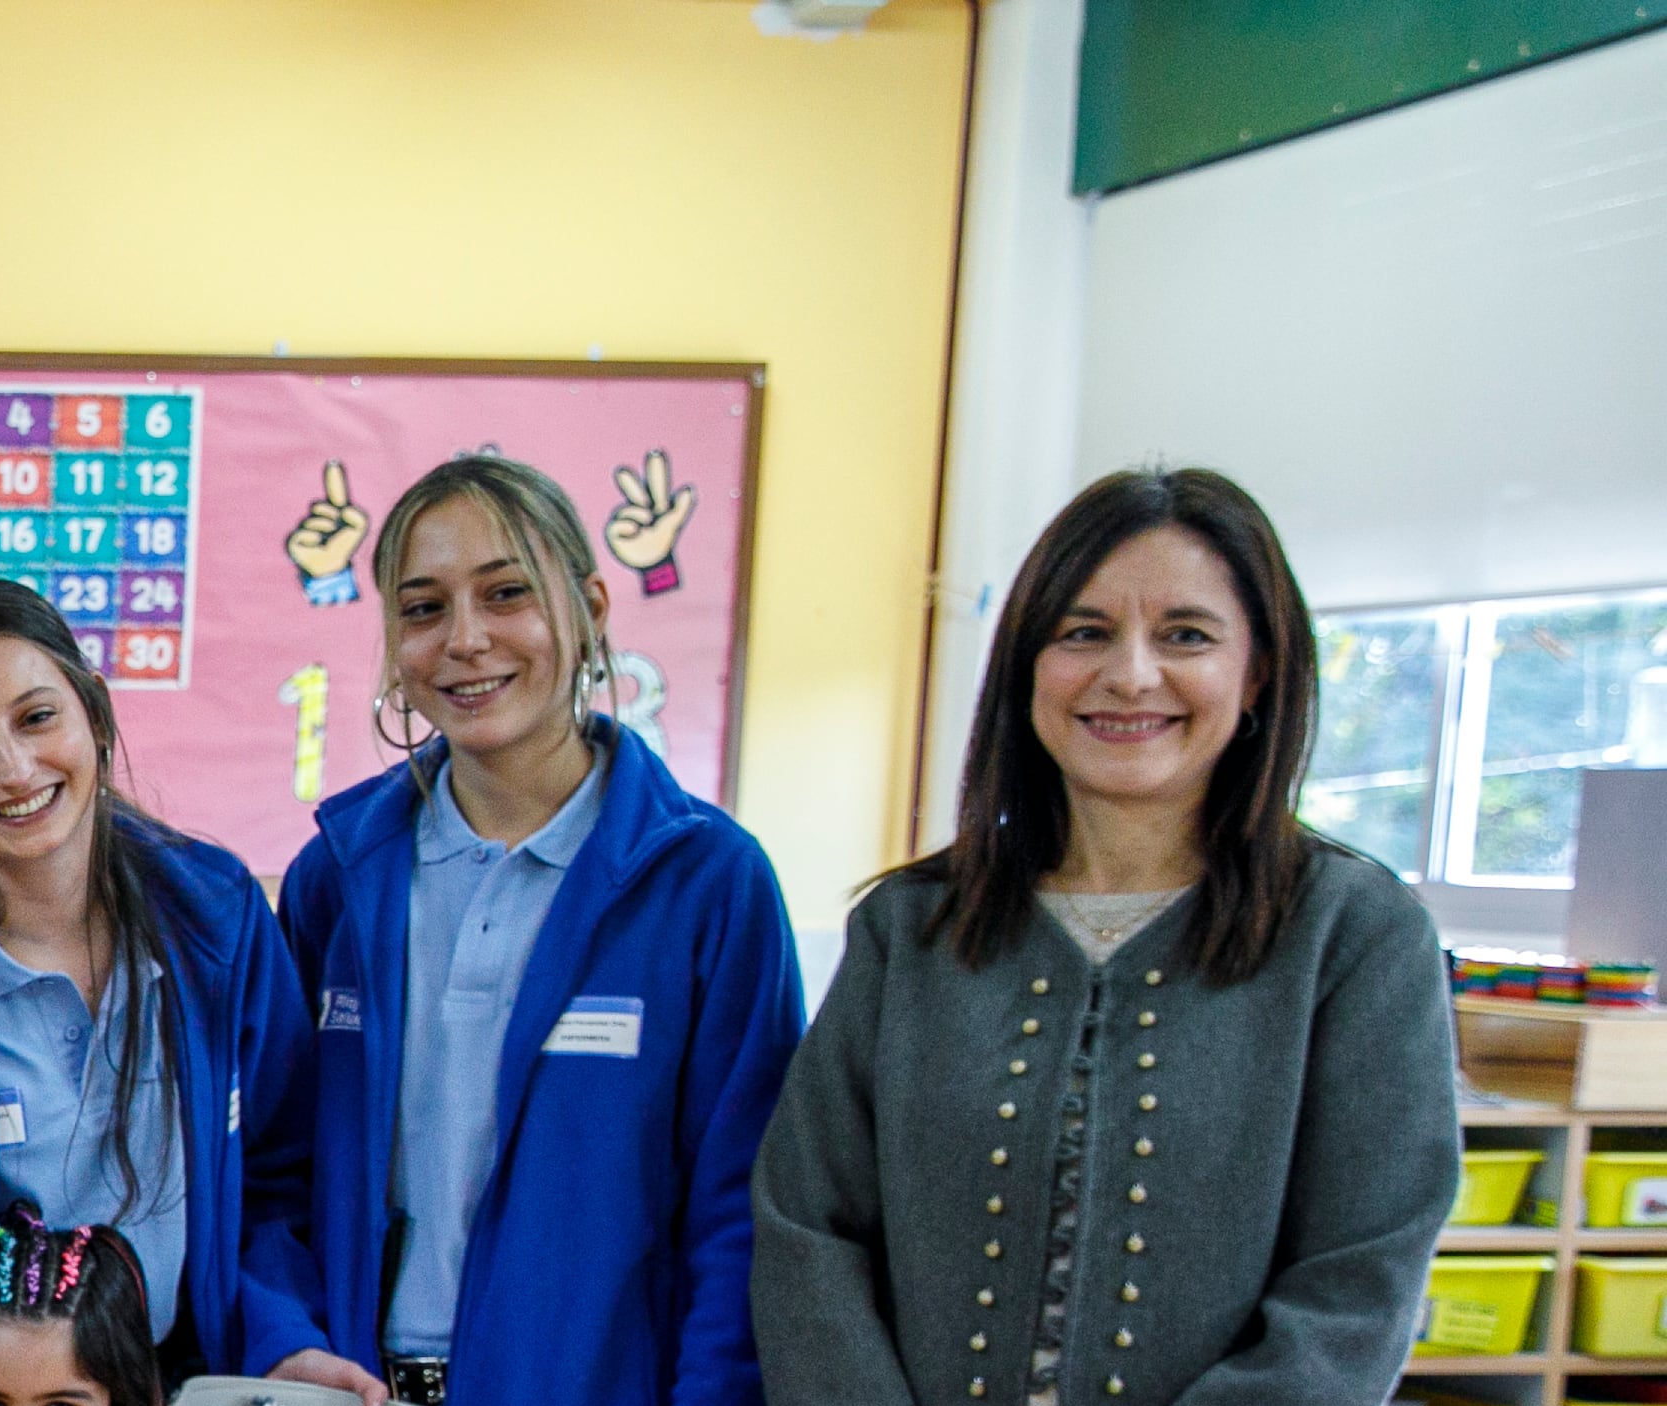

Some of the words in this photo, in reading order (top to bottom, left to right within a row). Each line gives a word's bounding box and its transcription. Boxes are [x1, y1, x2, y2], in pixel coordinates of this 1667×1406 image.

[7, 401, 33, 435] 4
[76, 401, 102, 437] 5
[147, 404, 170, 437] 6
[72, 462, 102, 493] 11
[138, 462, 176, 494] 12
[67, 519, 104, 551] 17
[136, 519, 174, 554] 18
[60, 577, 106, 610] 23
[131, 578, 178, 612] 24
[126, 635, 172, 671] 30
[278, 663, 329, 803] 1
